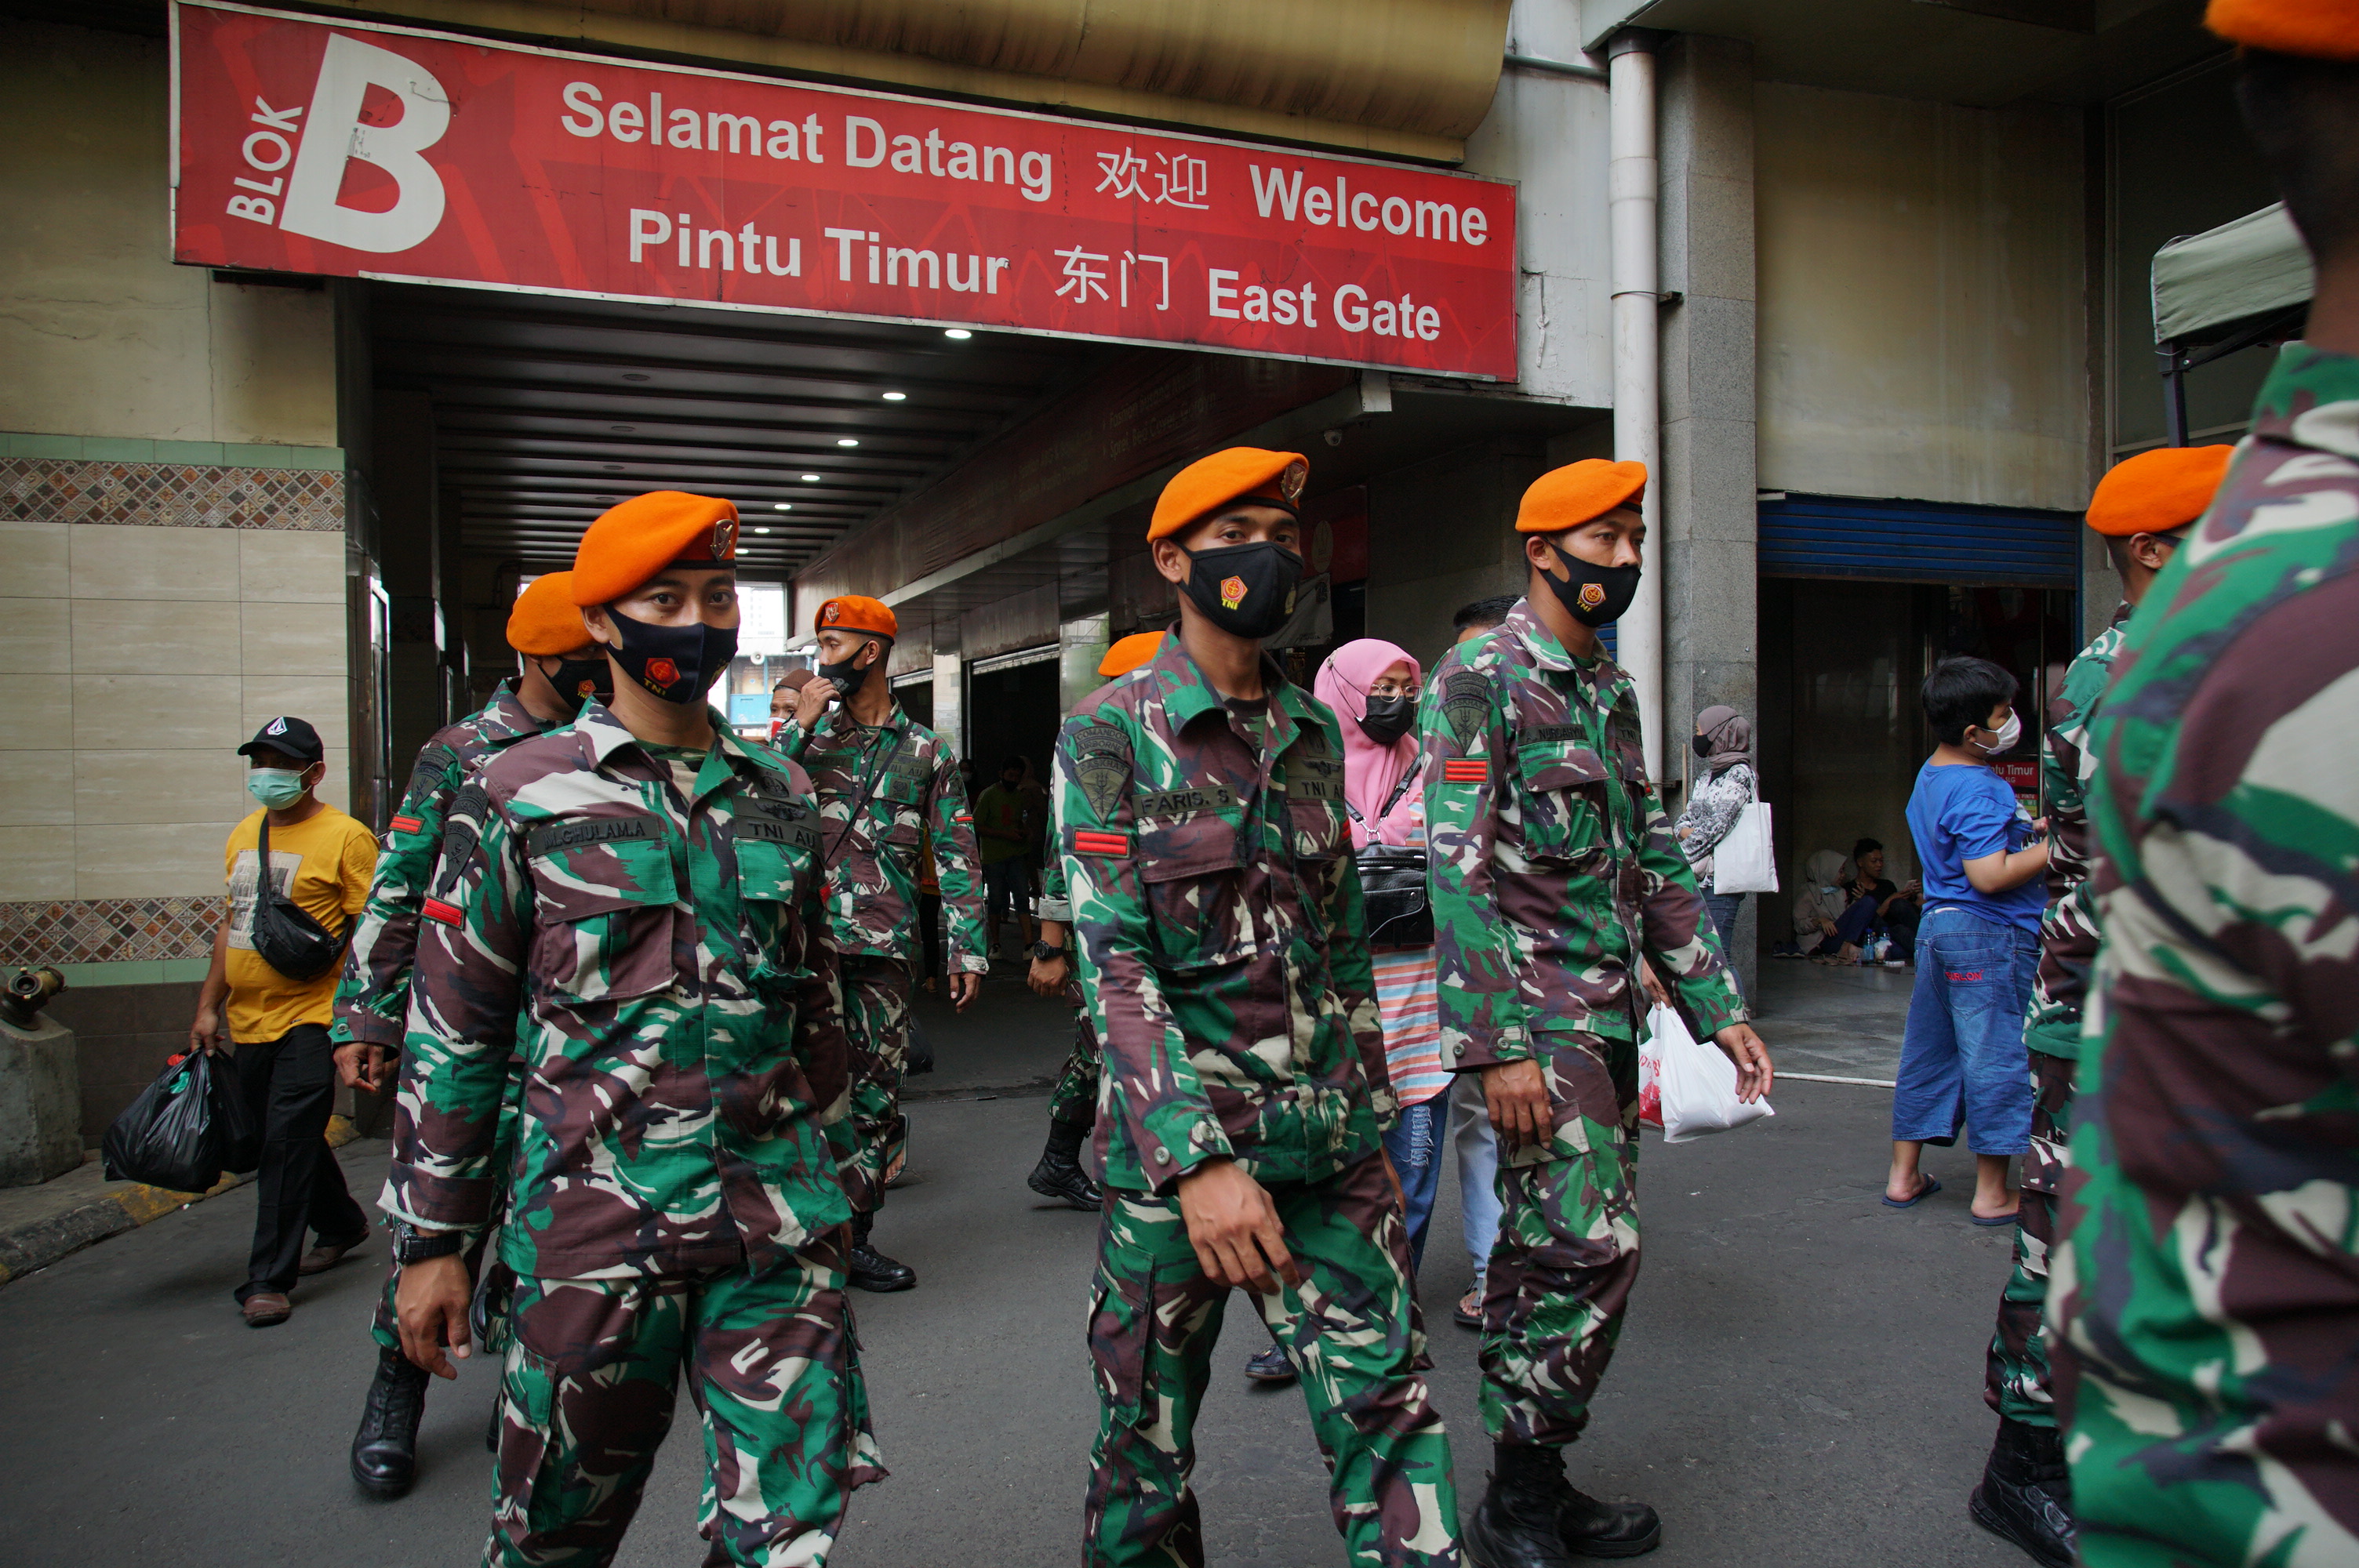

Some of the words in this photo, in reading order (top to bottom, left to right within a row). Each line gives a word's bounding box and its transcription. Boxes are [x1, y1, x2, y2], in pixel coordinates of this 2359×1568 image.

[279, 33, 451, 253] B
[561, 82, 824, 165] Selamat
[845, 115, 1052, 202] Datang
[226, 95, 304, 226] BLOK
[1095, 146, 1210, 211] 欢迎
[1249, 164, 1488, 246] Welcome
[629, 208, 801, 281] Pintu
[824, 227, 1009, 296] Timur
[1054, 245, 1169, 311] 东门
[1209, 268, 1318, 328] East
[1333, 284, 1441, 341] Gate
[1221, 598, 1238, 610] TNI
[1576, 599, 1592, 612] TNI
[643, 677, 667, 696] TNI
[1448, 684, 1484, 697] AIRBORNE
[1447, 699, 1484, 710] PASKHAS
[1077, 728, 1128, 742] COMANDOS
[1619, 728, 1637, 742] TNI
[1078, 739, 1124, 753] AIRBORNE
[908, 767, 924, 777] AU
[1080, 759, 1125, 772] PASKHAS
[1991, 764, 2005, 775] ntu
[2006, 764, 2034, 775] Timur
[1301, 780, 1327, 797] TNI
[1142, 790, 1209, 815] FARIS.
[1217, 787, 1230, 804] S
[747, 821, 785, 840] TNI
[794, 827, 817, 849] AU
